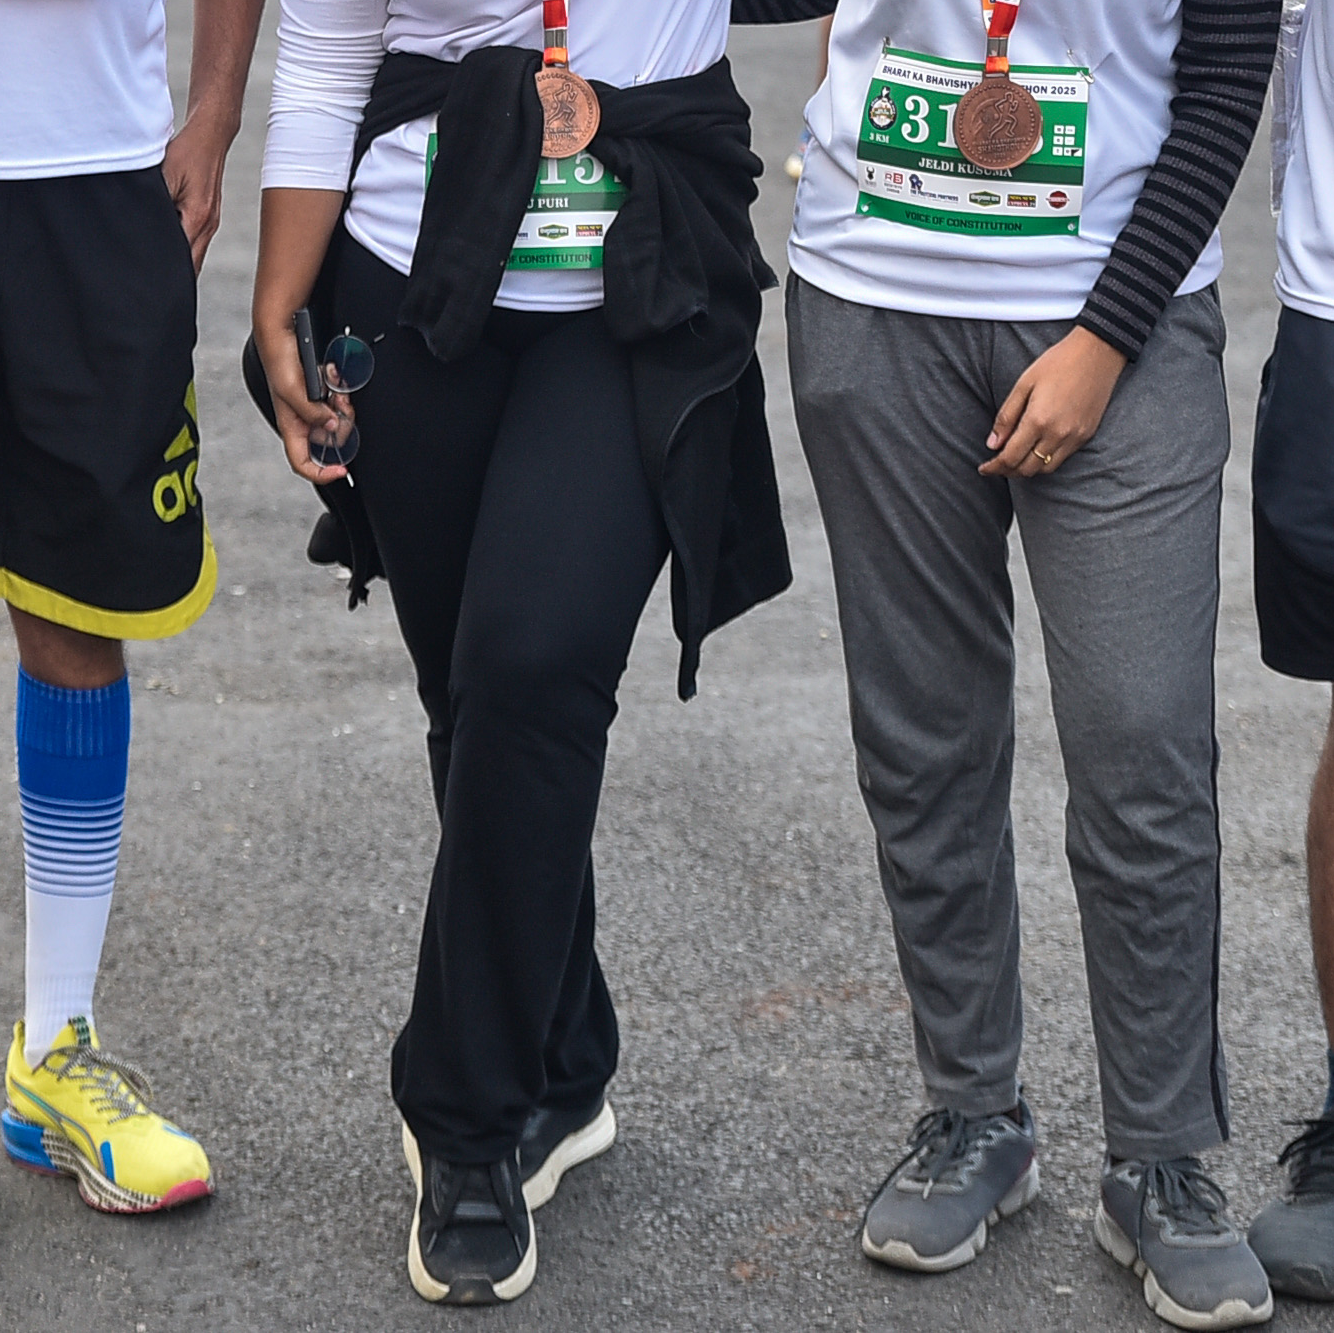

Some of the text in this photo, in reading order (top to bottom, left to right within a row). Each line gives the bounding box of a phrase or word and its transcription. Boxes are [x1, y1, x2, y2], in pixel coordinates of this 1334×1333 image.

[882, 65, 911, 80] BHARAT
[913, 71, 924, 83] KA
[1050, 86, 1077, 95] 2025
[876, 133, 890, 144] KM
[918, 157, 954, 172] JELDI
[537, 197, 569, 209] PURI
[905, 210, 1023, 232] VOICE OF CONSTITUTION
[519, 253, 592, 264] CONSTITUTION
